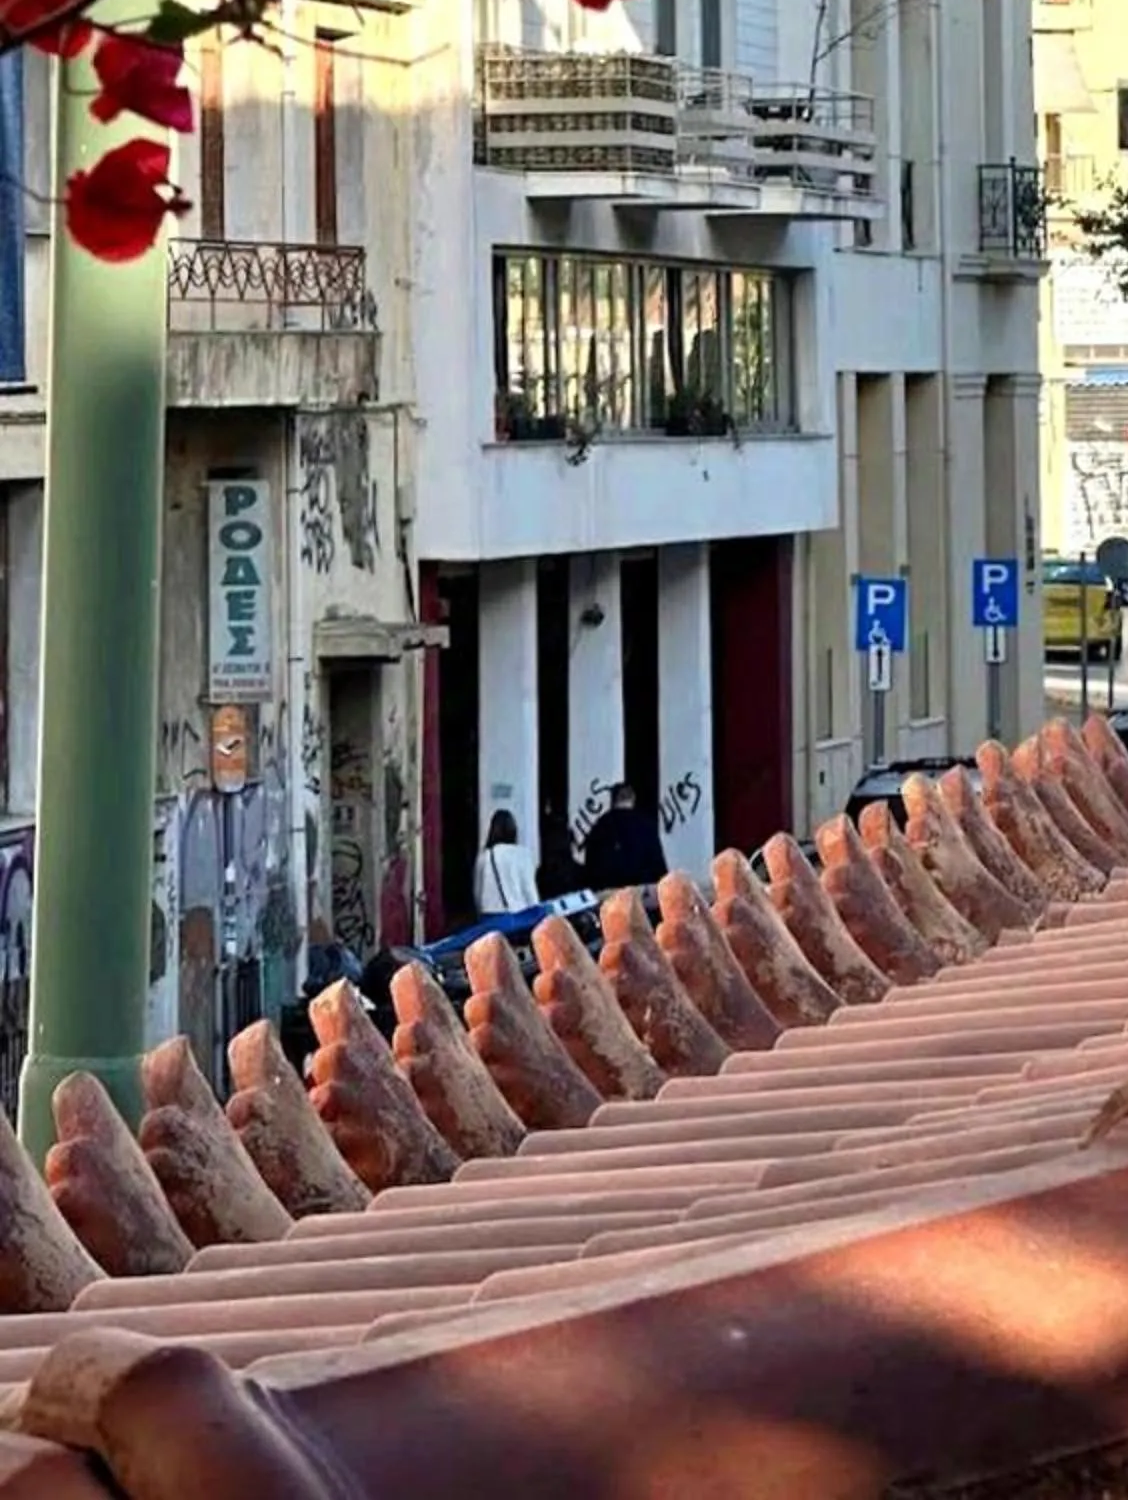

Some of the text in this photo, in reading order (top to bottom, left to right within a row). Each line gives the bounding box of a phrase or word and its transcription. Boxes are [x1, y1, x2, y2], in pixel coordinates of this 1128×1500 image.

[219, 485, 263, 656] ΡΟΔΕΣ
[981, 563, 1009, 595] P
[867, 584, 896, 616] P
